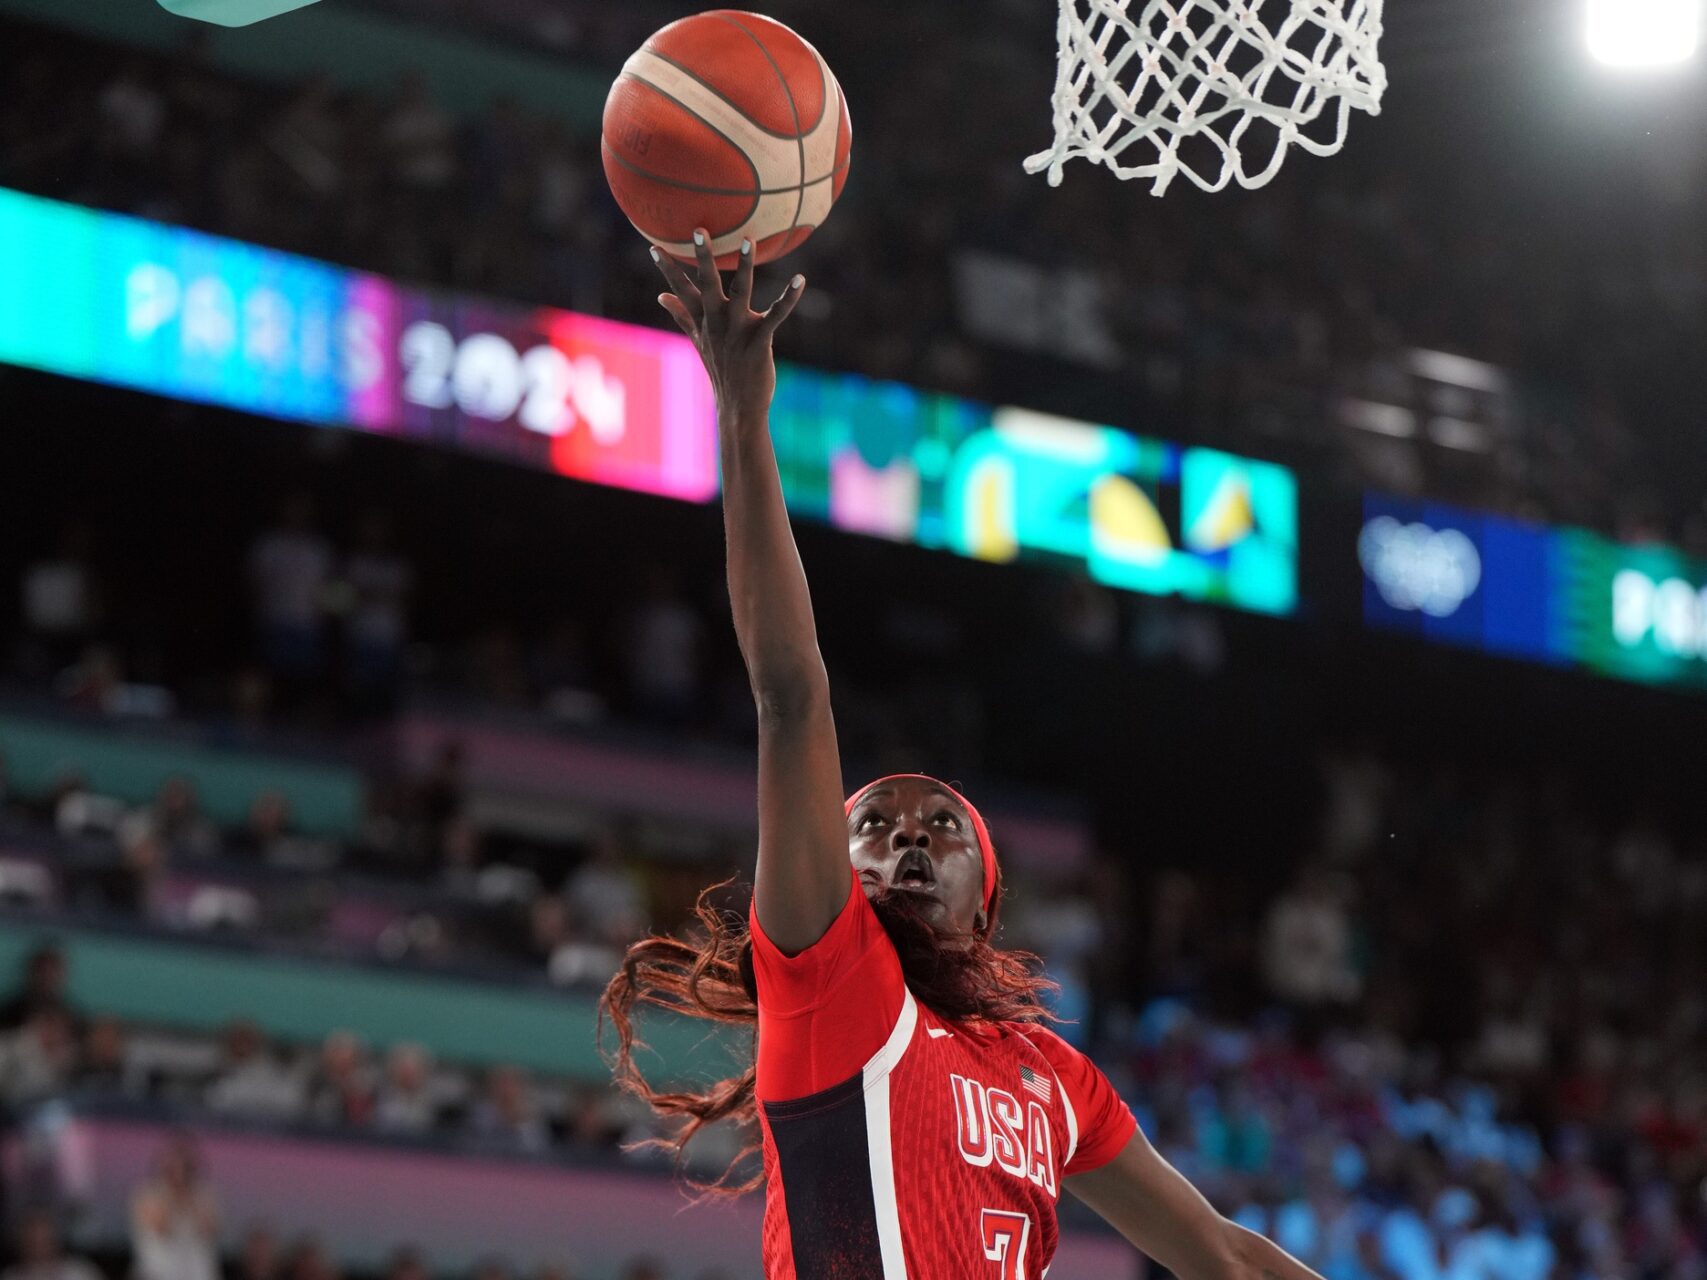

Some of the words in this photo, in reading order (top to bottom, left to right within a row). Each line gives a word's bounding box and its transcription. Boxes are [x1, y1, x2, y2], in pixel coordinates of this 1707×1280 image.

[126, 263, 385, 393] PARIS
[402, 321, 625, 445] 2024
[950, 1073, 1057, 1198] USA
